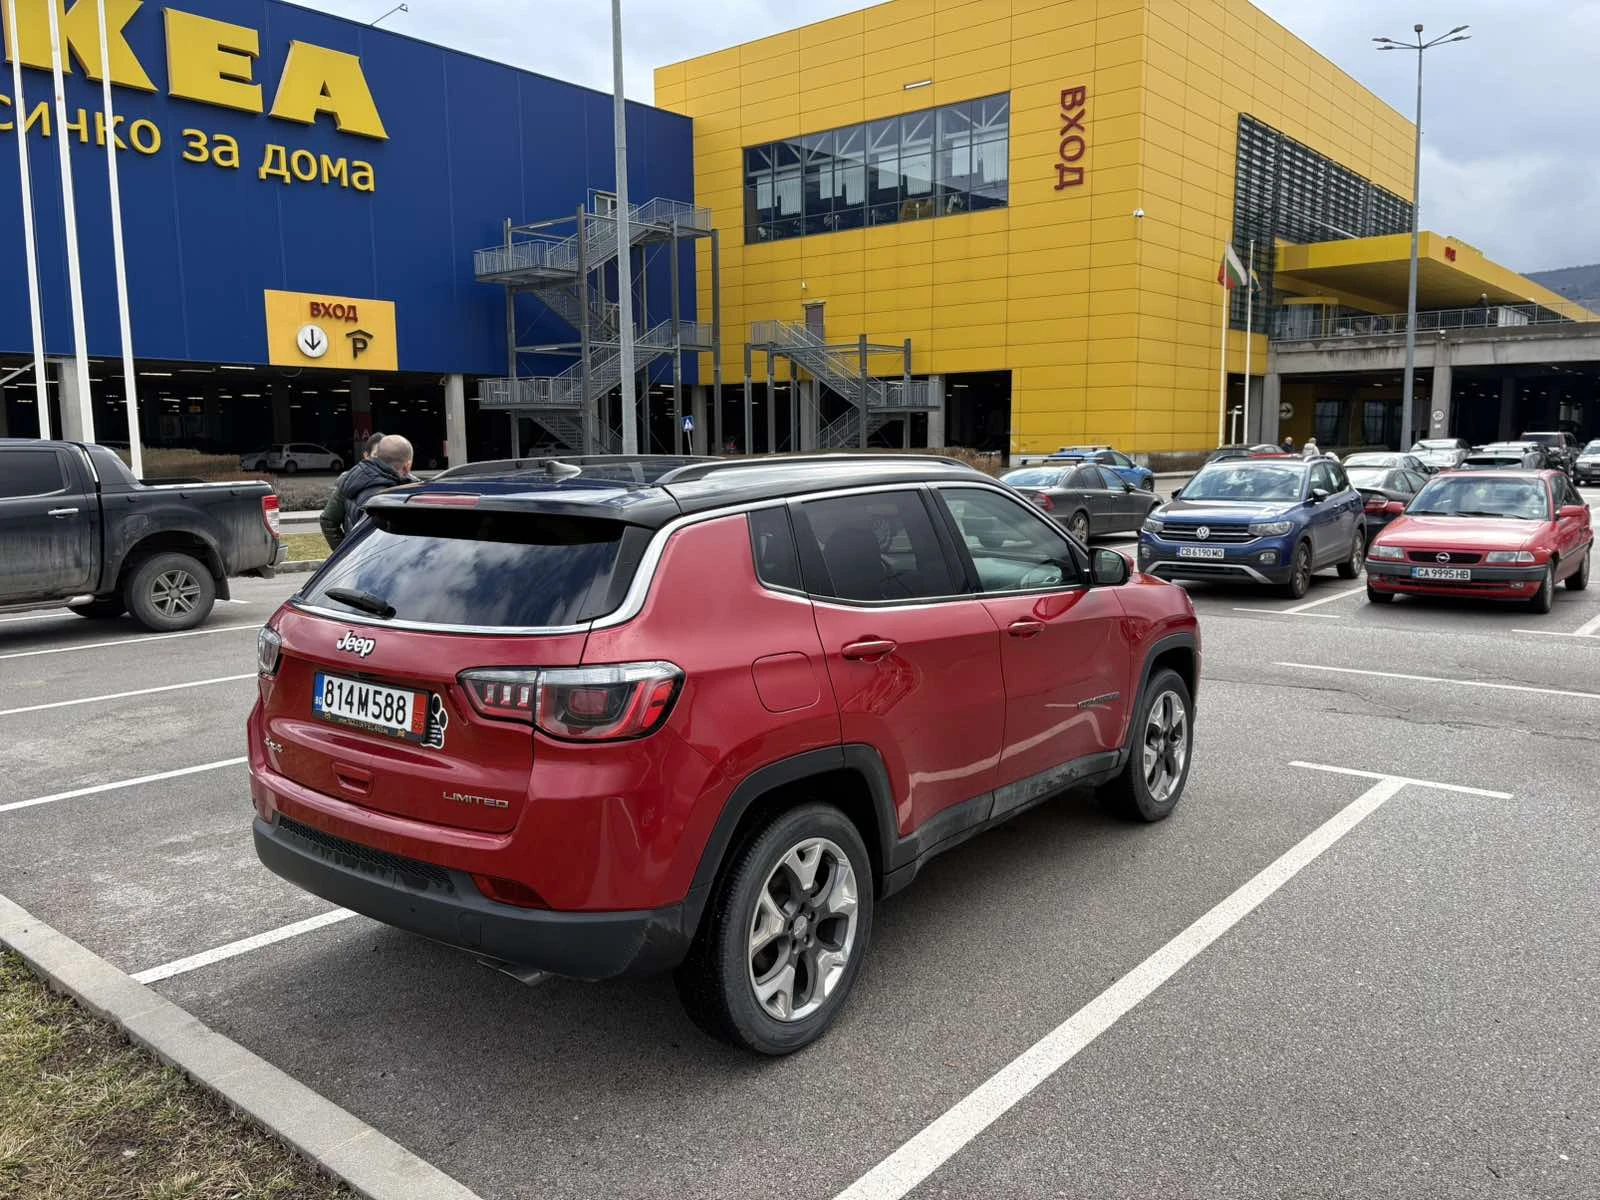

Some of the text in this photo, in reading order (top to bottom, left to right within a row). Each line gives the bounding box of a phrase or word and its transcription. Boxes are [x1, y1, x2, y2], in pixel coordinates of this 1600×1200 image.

[1054, 85, 1086, 191] ВХОД
[182, 128, 240, 168] за
[258, 143, 375, 192] дома
[310, 301, 359, 323] ВХОД
[336, 630, 376, 658] Jeep
[324, 679, 407, 725] 814M588
[443, 791, 509, 808] LIMITED
